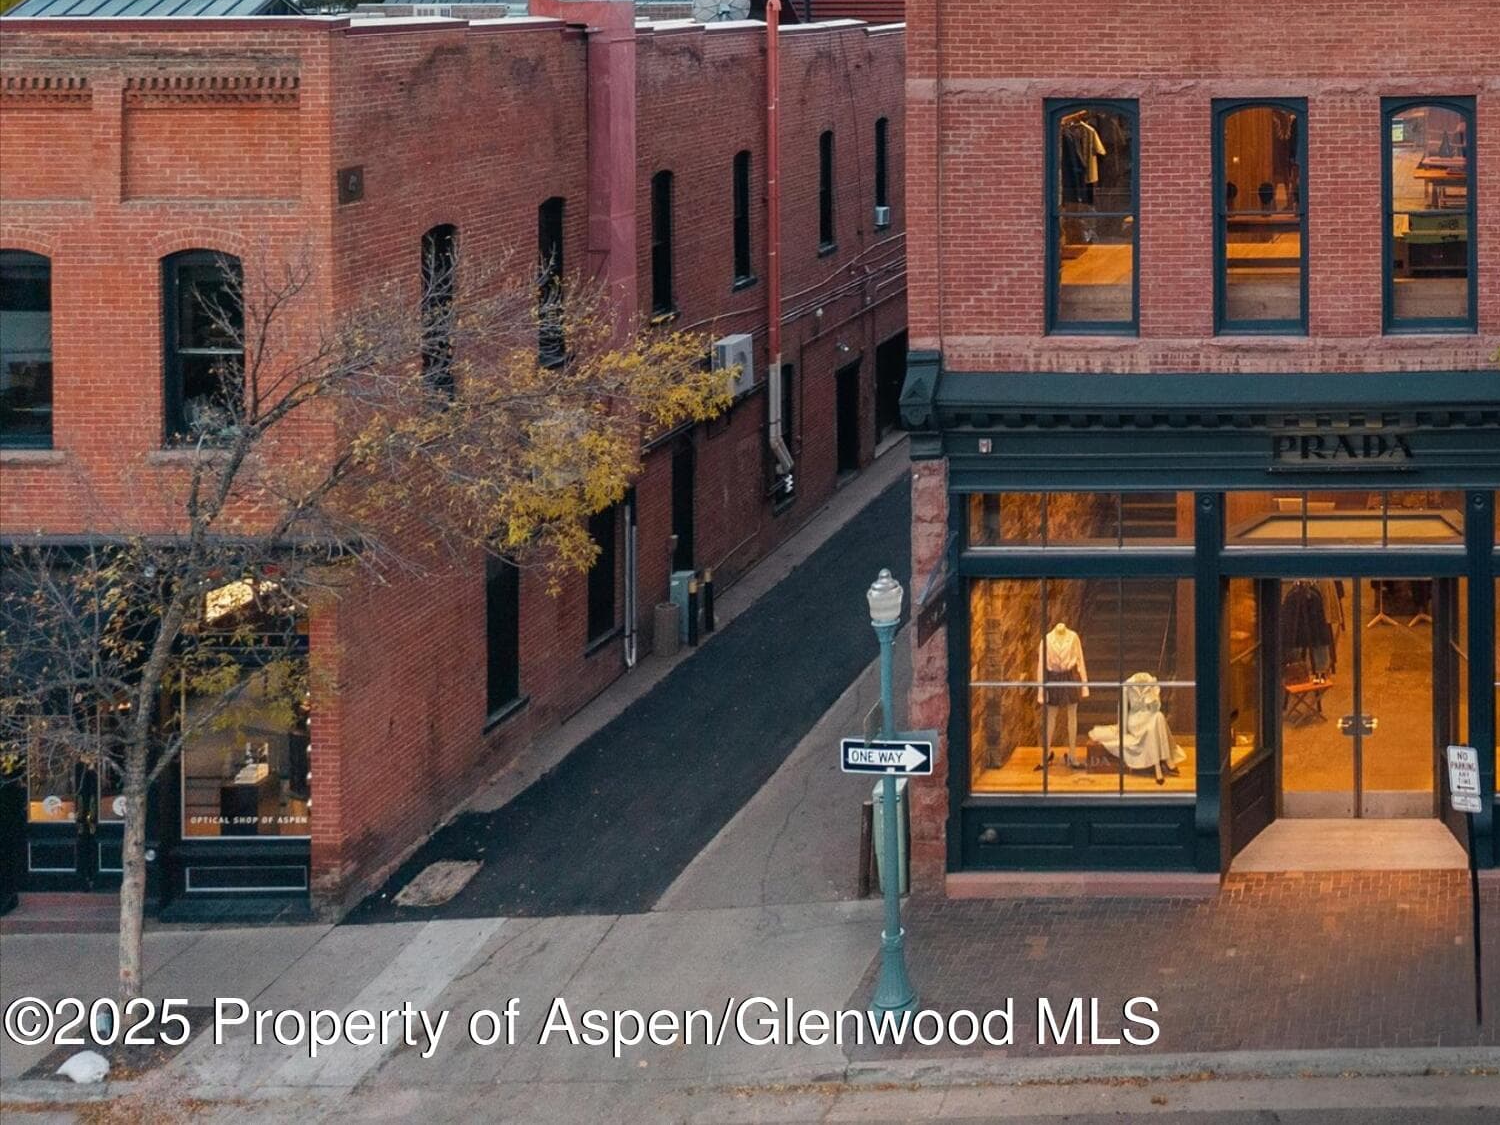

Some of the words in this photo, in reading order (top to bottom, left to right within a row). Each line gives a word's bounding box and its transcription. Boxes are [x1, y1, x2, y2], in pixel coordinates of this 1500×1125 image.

[1273, 434, 1415, 460] PRADA
[851, 750, 875, 763] ONE
[878, 751, 904, 764] WAY
[1457, 751, 1468, 761] NO
[1450, 761, 1476, 772] PARKING
[190, 816, 230, 824] OPTICAL
[233, 816, 259, 824] SHOP
[261, 816, 274, 824] OF
[277, 816, 308, 824] ASPEN
